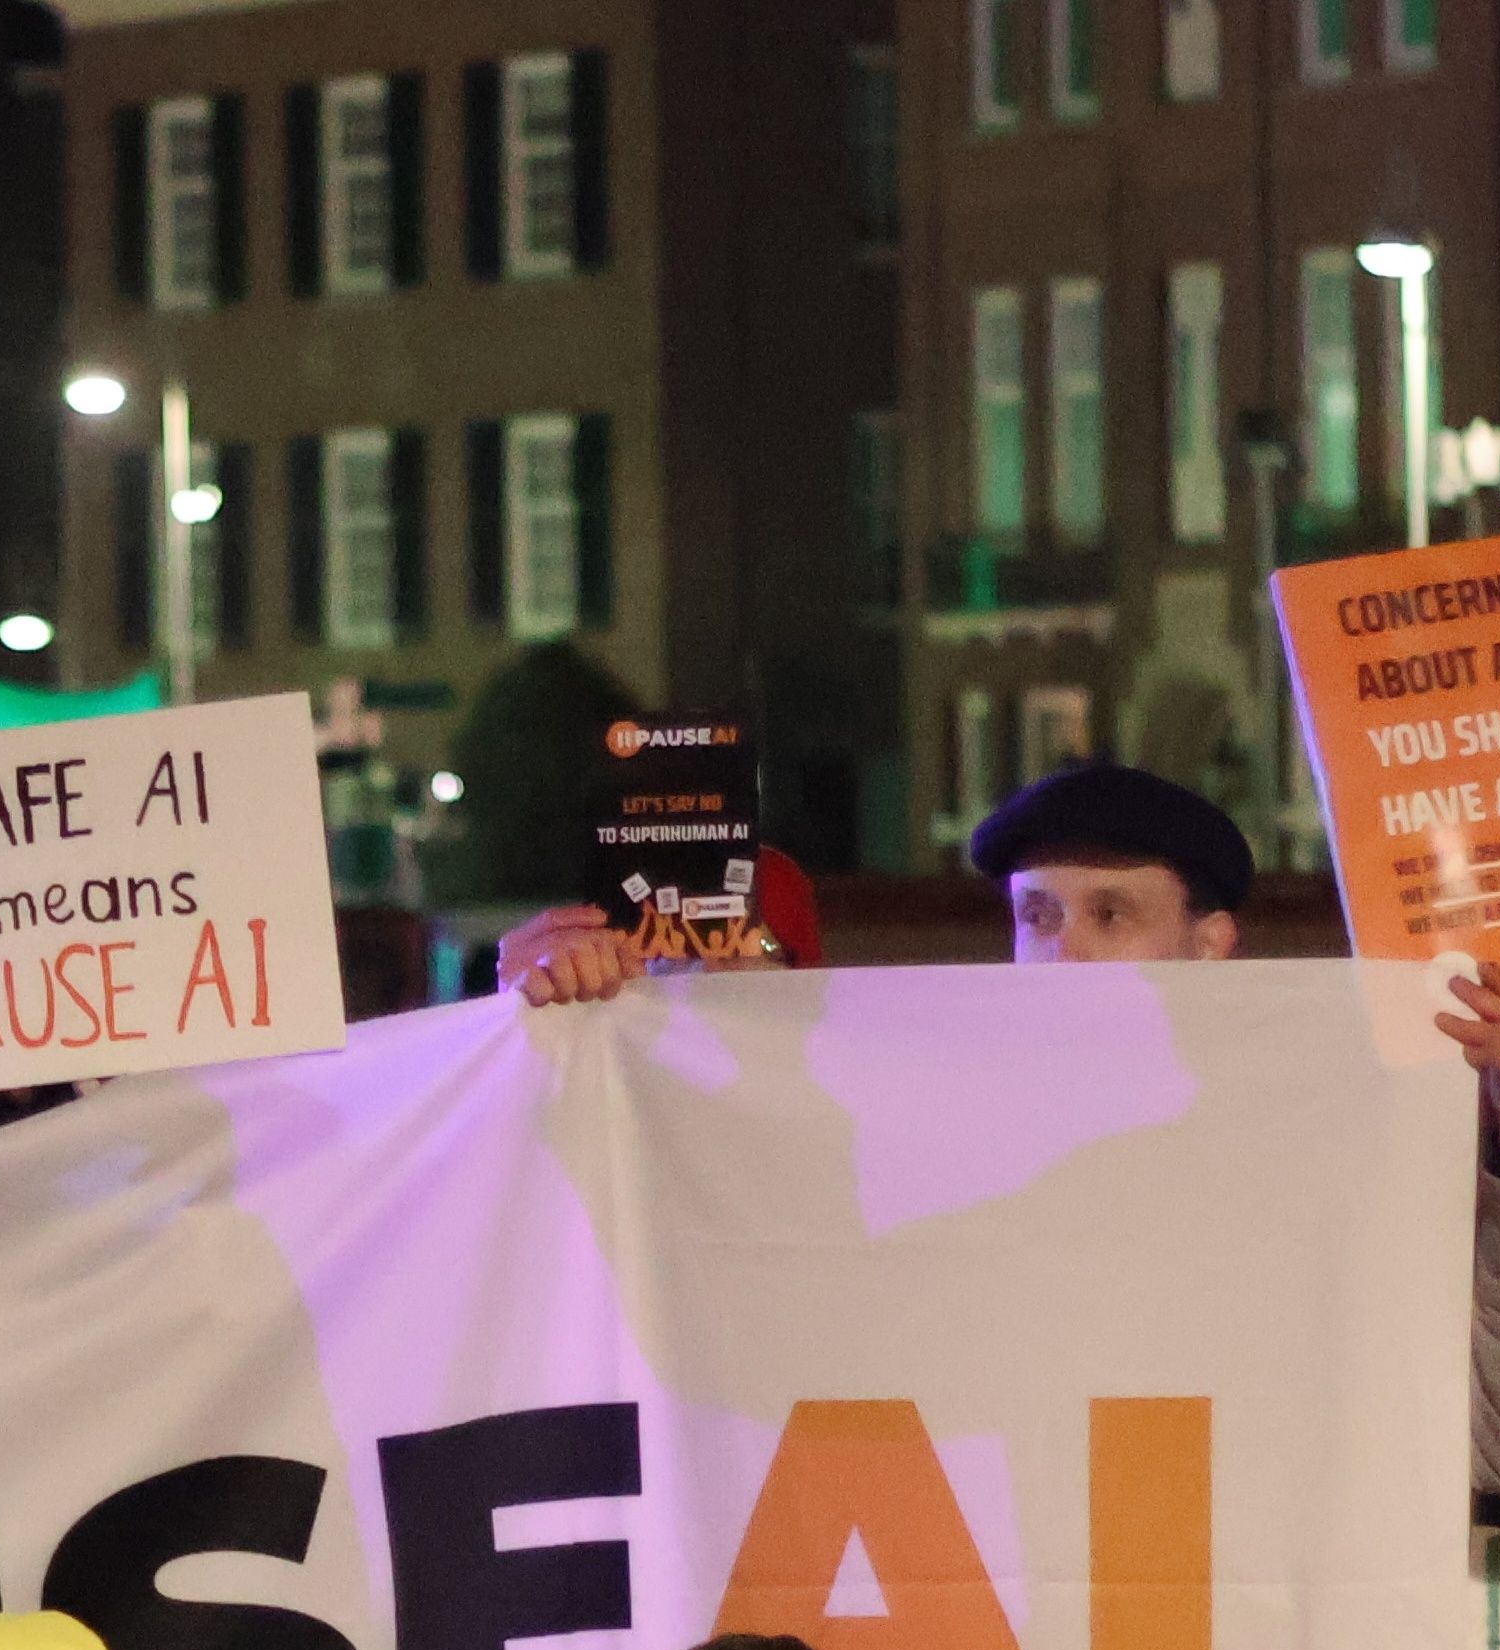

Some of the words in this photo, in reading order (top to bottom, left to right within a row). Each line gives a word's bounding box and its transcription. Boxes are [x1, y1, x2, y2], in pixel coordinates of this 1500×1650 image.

[1356, 646, 1478, 701] ABOUT
[1368, 720, 1446, 768] YOU
[136, 750, 209, 827] AI
[1380, 783, 1487, 836] HAVE
[597, 827, 617, 844] TO
[619, 824, 729, 844] SUPERHUMAN
[732, 823, 749, 840] AI
[177, 918, 272, 1034] AI
